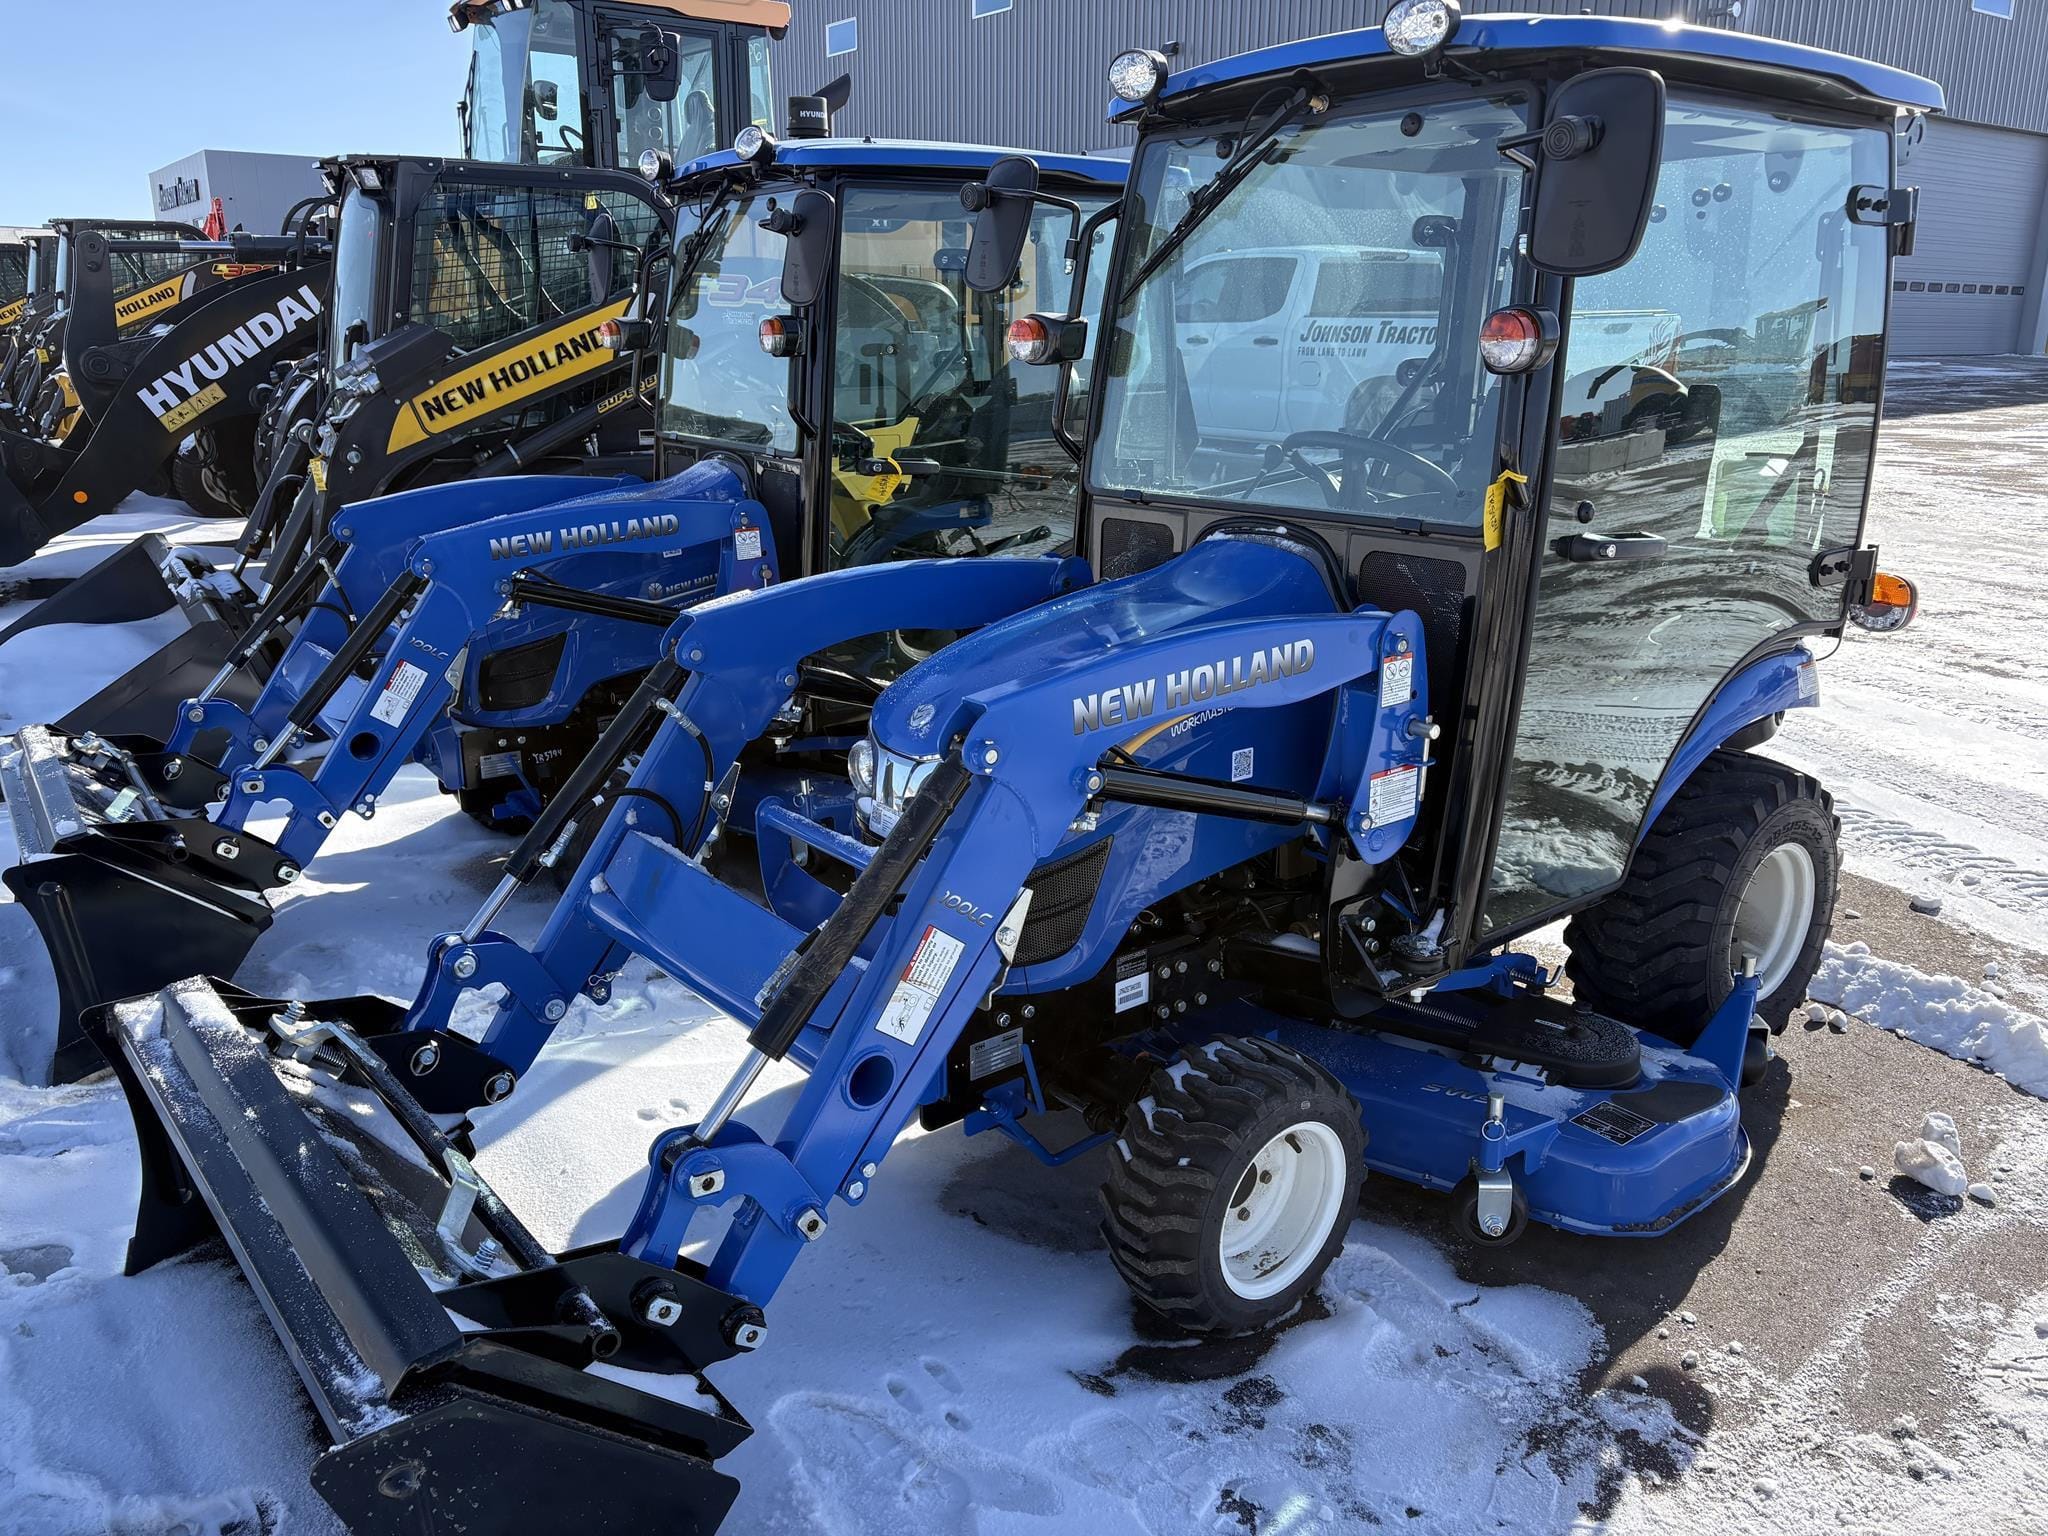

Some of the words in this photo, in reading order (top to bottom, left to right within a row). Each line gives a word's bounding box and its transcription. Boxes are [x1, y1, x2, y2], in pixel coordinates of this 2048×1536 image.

[799, 109, 826, 118] HYUND
[116, 286, 176, 318] HOLLAND
[136, 284, 322, 418] HYUNDAI
[1301, 320, 1373, 344] JOHNSON
[1376, 320, 1438, 345] TRACTO
[421, 377, 486, 422] NEW
[487, 327, 603, 393] HOLLAND
[489, 531, 552, 560] NEW
[560, 513, 680, 550] HOLLAND
[664, 580, 694, 595] NEW
[1073, 678, 1156, 736] NEW
[1166, 638, 1315, 711] HOLLAND
[939, 890, 994, 927] 100LC
